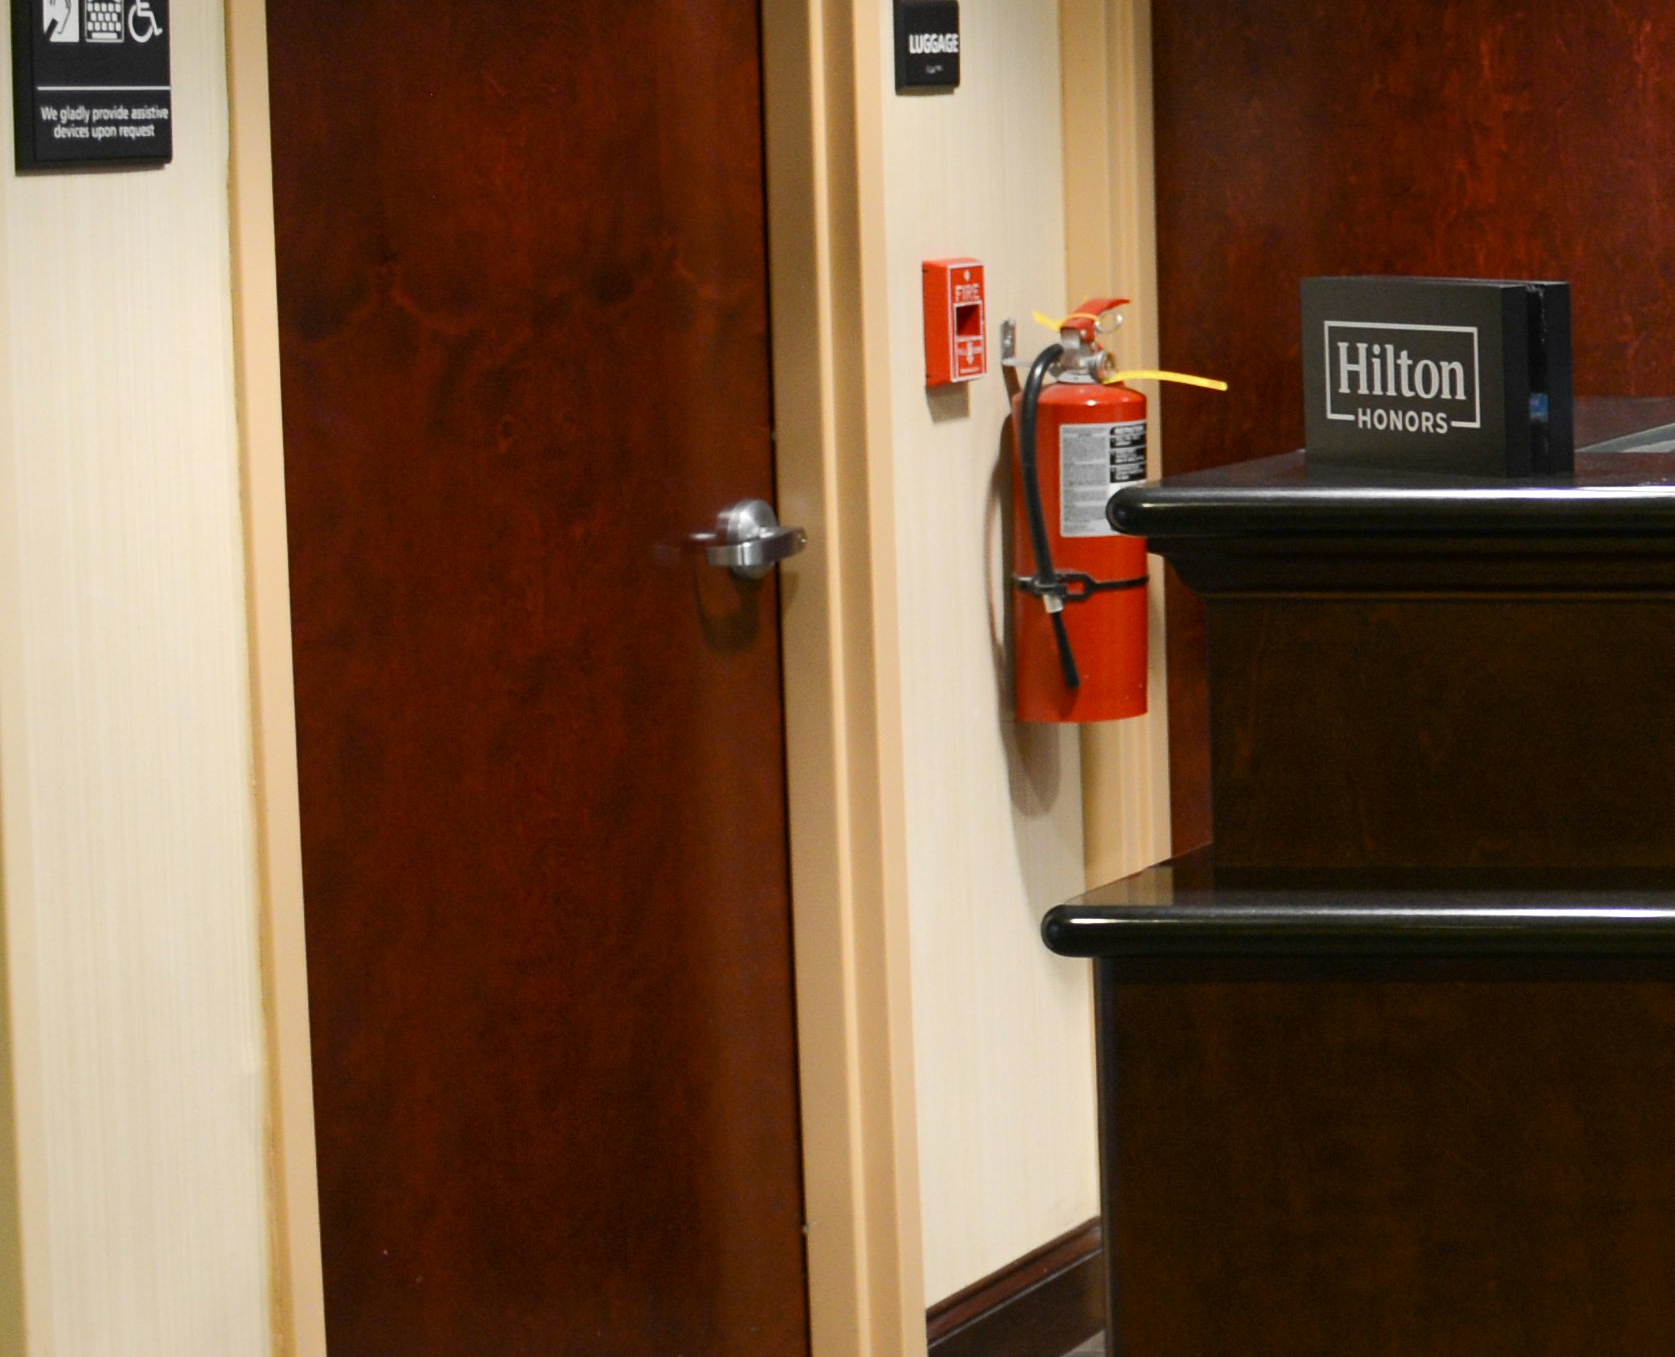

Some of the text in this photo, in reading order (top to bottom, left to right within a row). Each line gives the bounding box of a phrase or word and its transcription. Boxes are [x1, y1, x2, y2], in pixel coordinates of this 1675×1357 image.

[908, 33, 960, 54] LUGGAGE
[40, 105, 170, 124] We gladly provide assistive
[53, 123, 156, 141] devices upon request
[955, 283, 981, 302] FIRE
[1336, 341, 1467, 401] Hilton
[1357, 407, 1448, 434] HONORS
